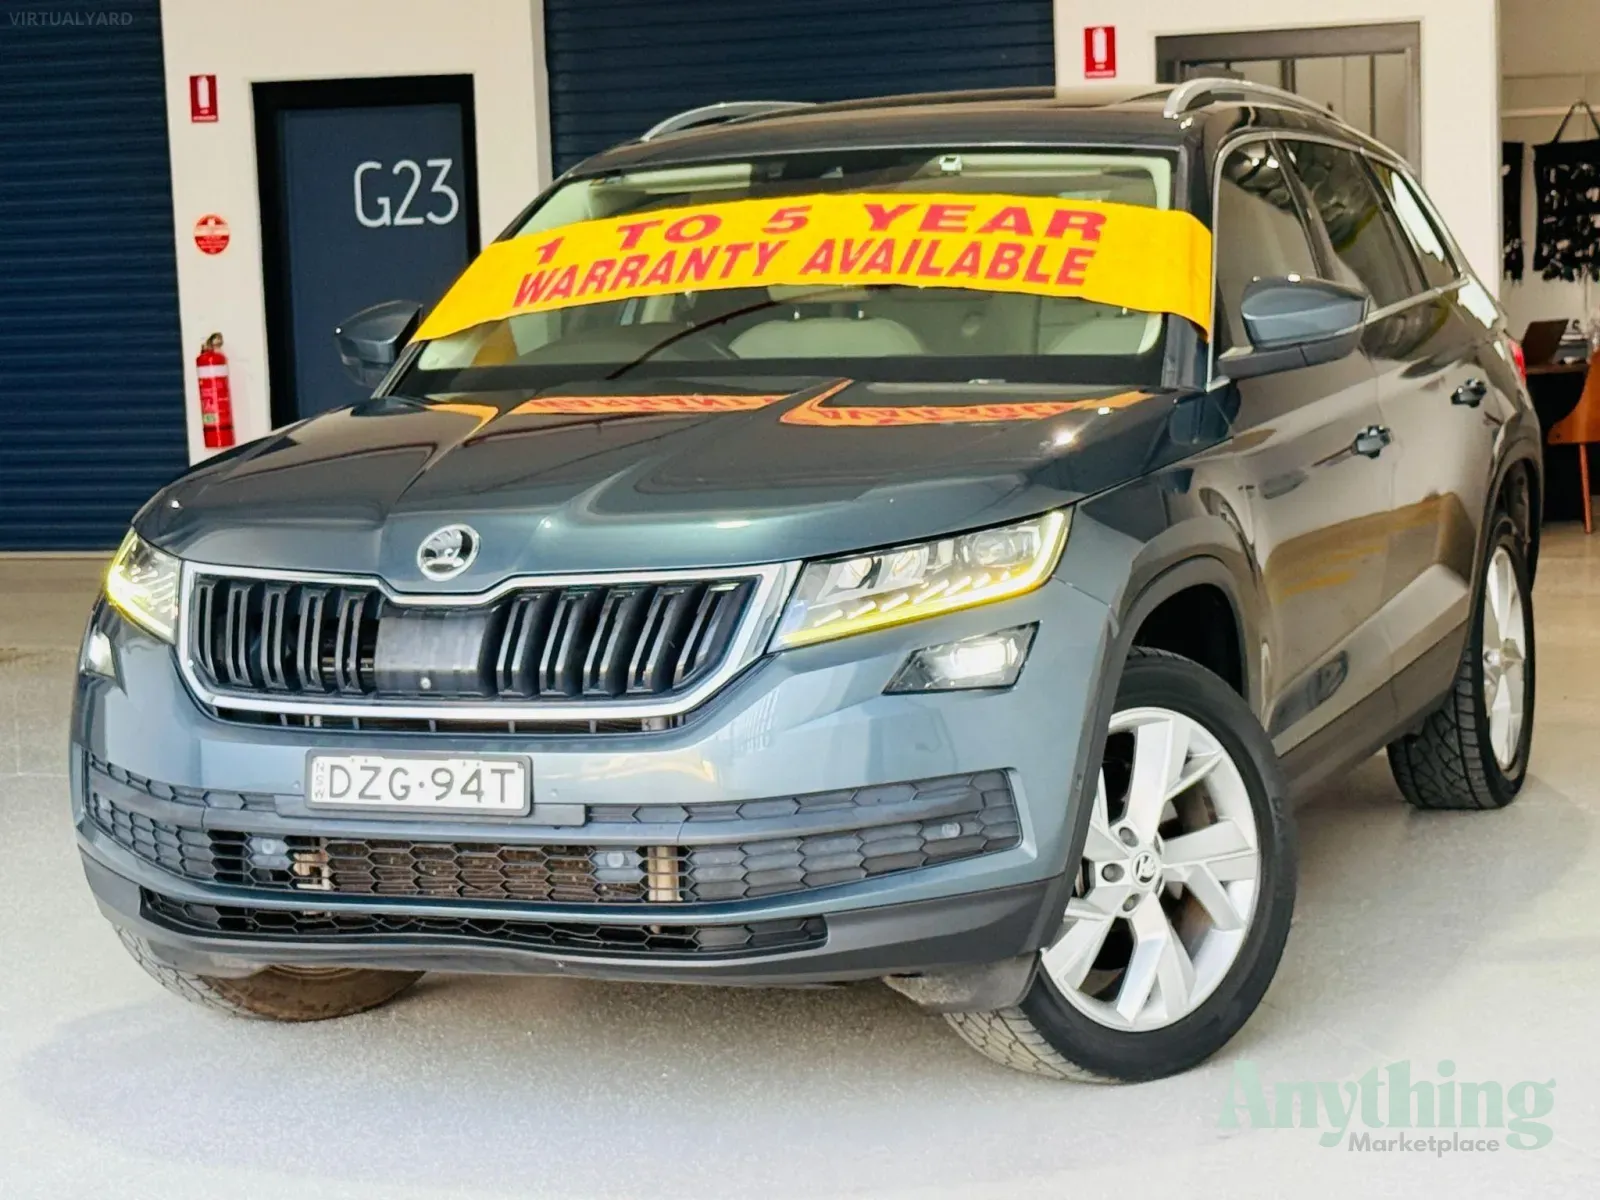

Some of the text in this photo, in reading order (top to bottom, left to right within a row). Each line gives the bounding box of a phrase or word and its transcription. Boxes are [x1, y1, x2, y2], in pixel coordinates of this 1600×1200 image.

[354, 159, 459, 228] G23
[536, 203, 1107, 266] 1 TO 5 YEAR
[513, 238, 1096, 308] WARRANTY AVAILABLE
